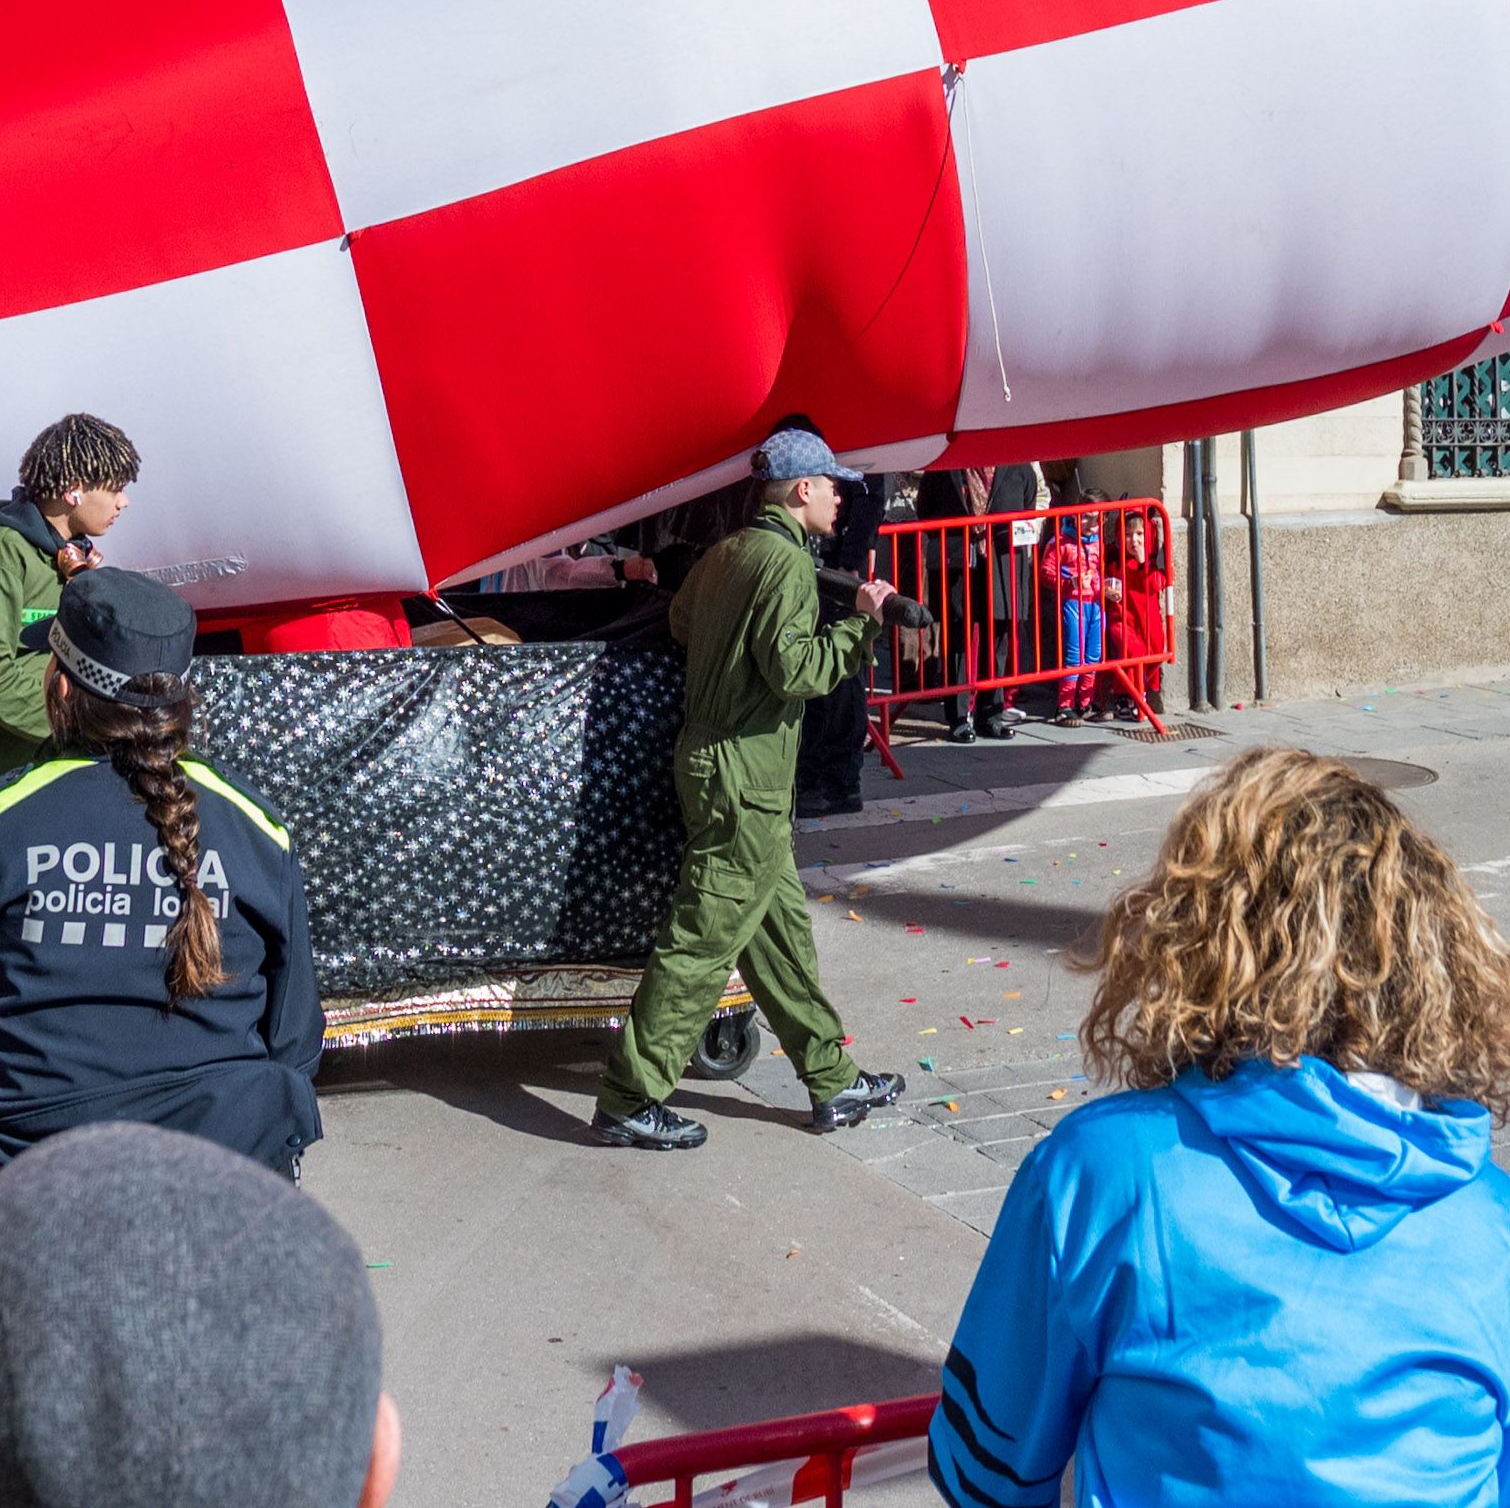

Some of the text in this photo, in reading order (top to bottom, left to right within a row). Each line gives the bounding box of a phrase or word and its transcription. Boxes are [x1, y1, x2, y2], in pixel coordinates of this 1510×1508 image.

[27, 842, 229, 889] POLICA
[25, 884, 229, 919] policia loal
